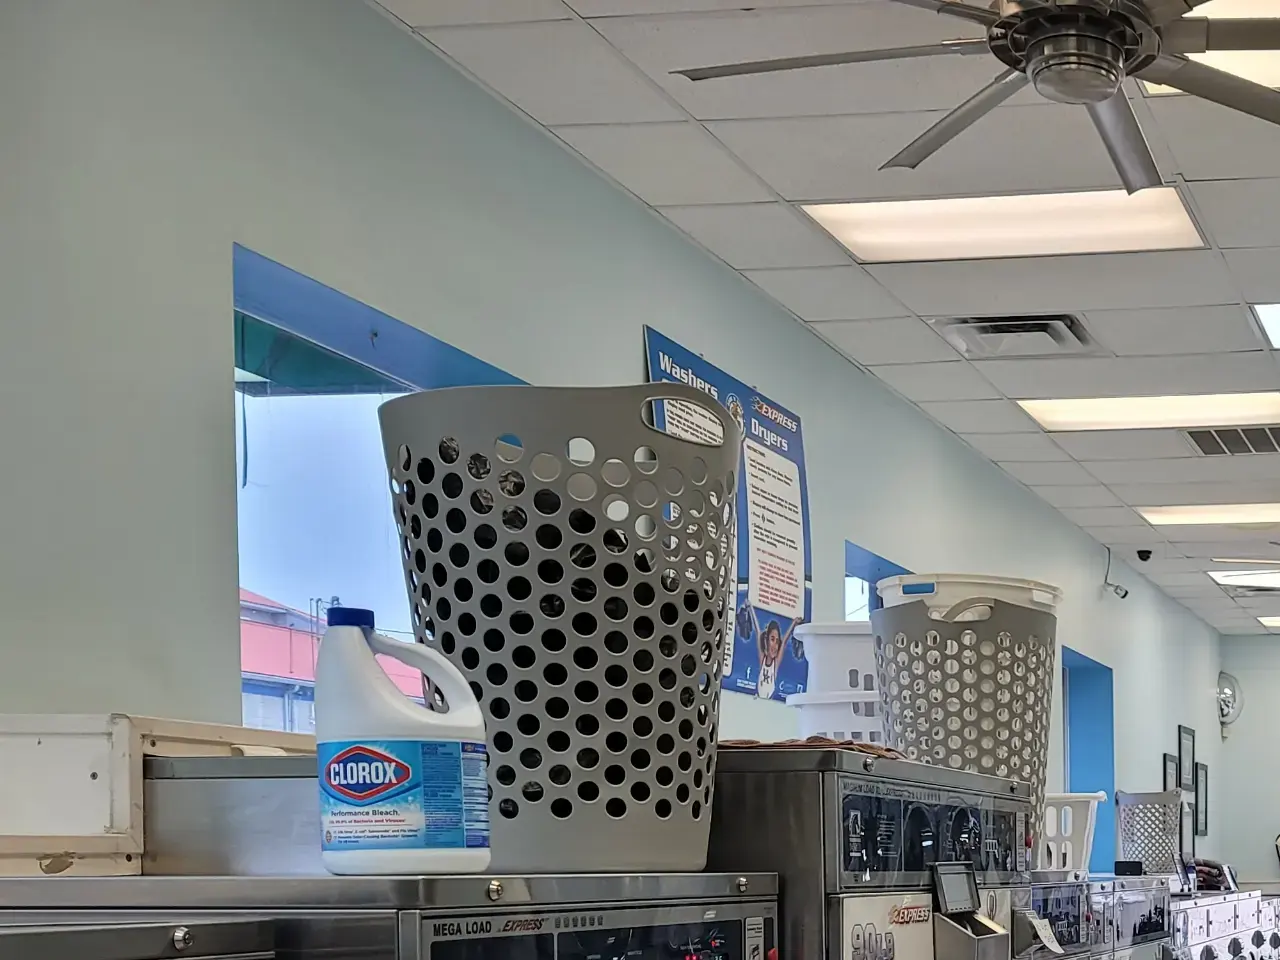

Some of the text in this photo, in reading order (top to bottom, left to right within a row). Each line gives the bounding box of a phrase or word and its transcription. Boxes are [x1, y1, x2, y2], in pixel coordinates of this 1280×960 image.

[659, 351, 718, 400] Washers
[761, 404, 797, 432] EXPRESS
[751, 418, 788, 451] Dryers
[330, 762, 398, 785] CLOROX
[433, 918, 546, 937] MEGA LOAD EXPRESS
[899, 907, 930, 923] EXPRESS
